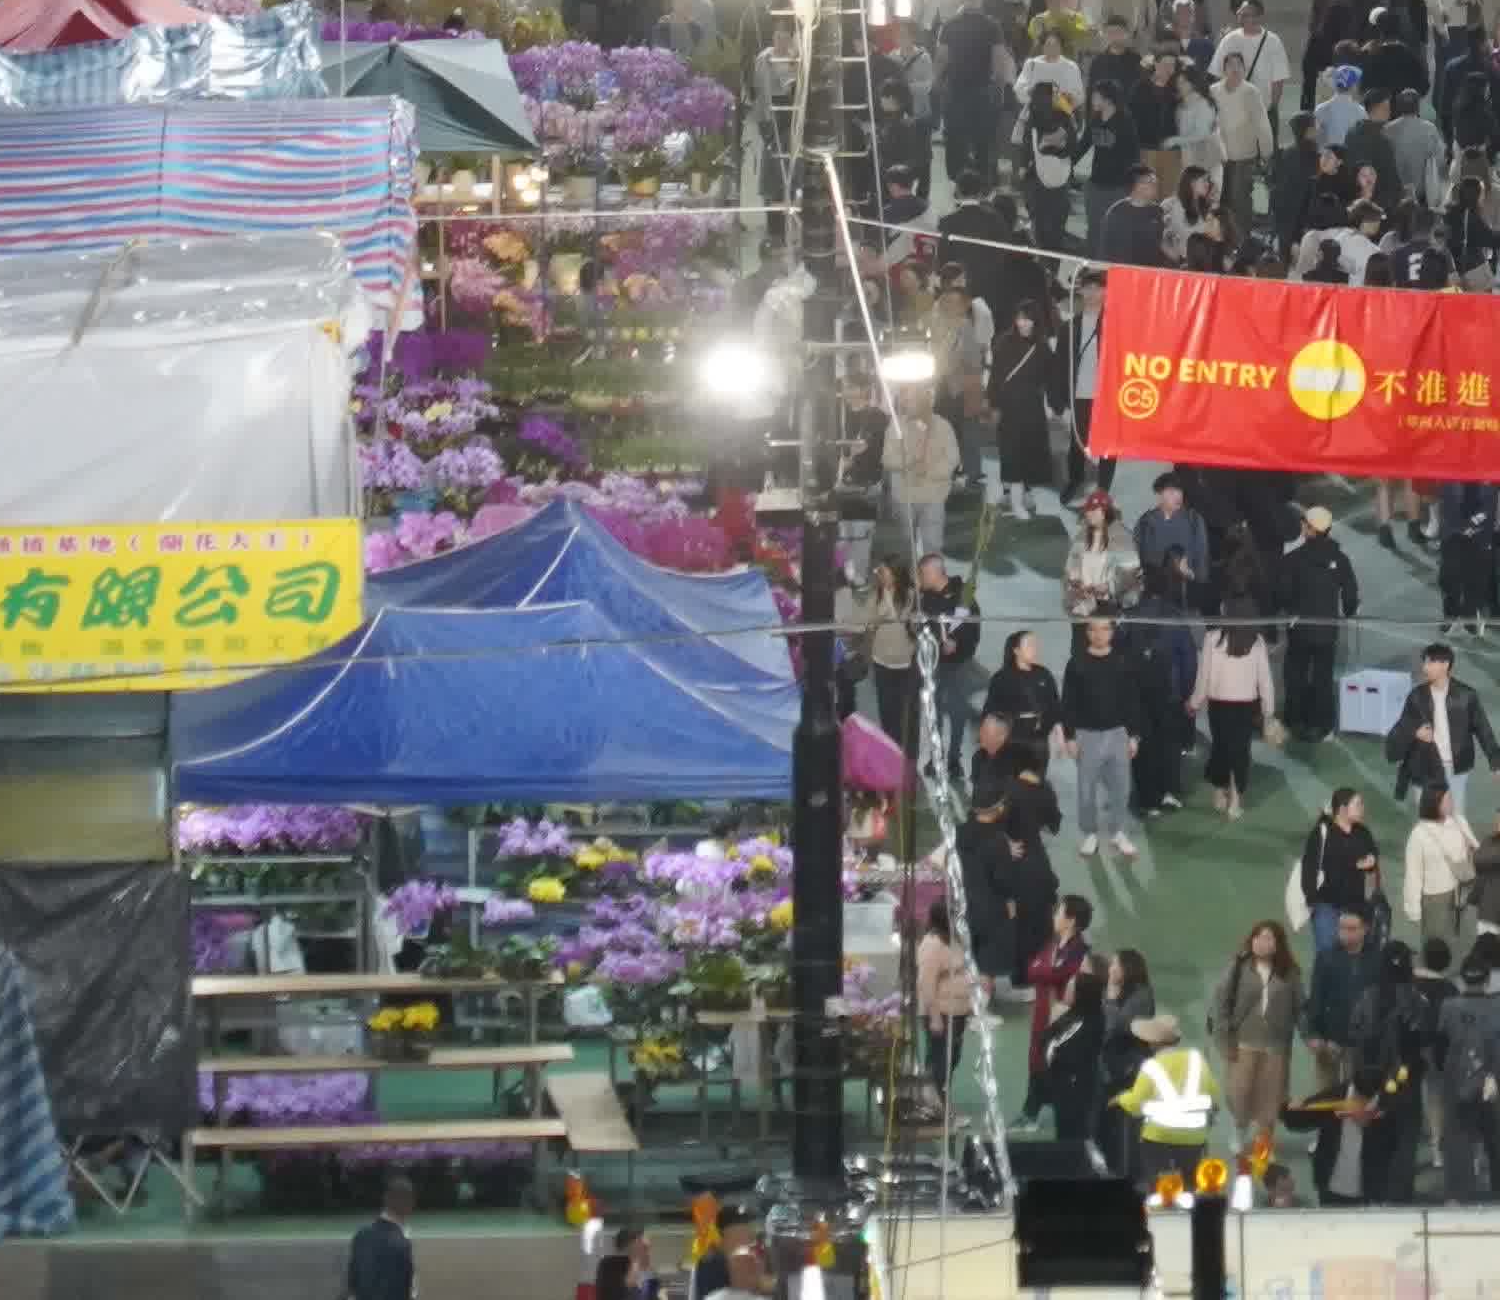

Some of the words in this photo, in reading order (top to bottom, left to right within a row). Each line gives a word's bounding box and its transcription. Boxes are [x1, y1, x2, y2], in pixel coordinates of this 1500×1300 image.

[1123, 352, 1172, 381] NO
[1178, 357, 1277, 390] ENTRY
[1122, 384, 1154, 409] C5
